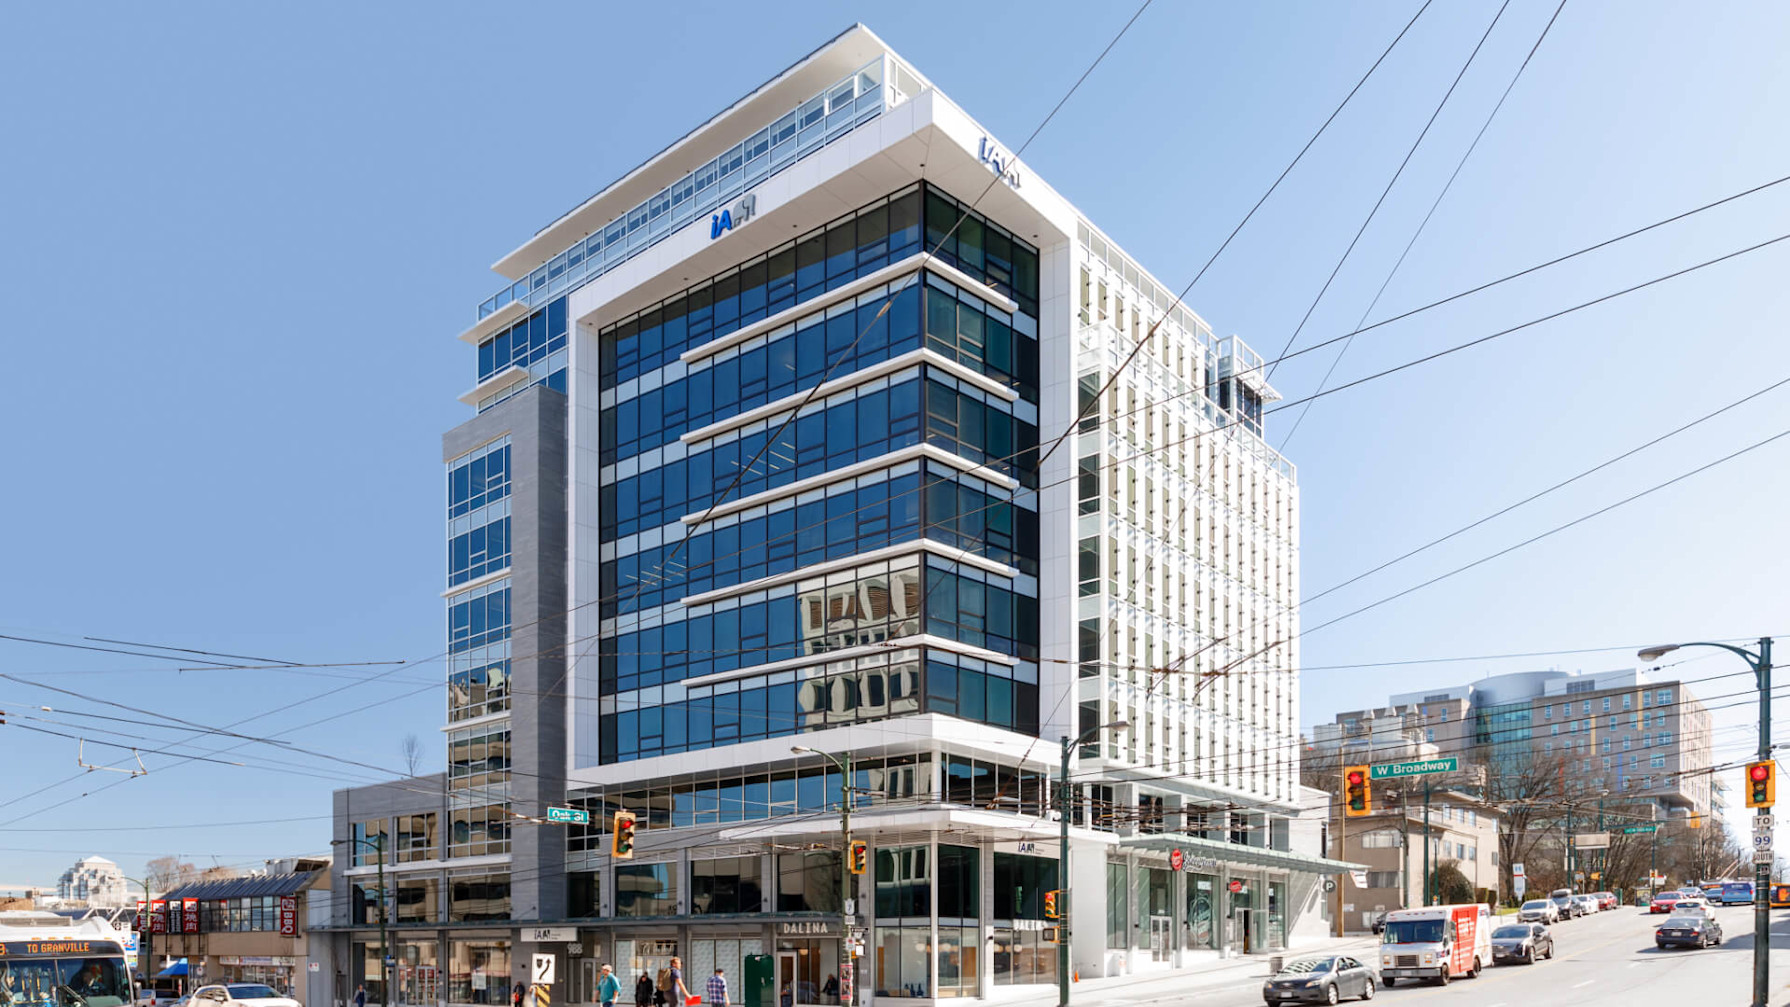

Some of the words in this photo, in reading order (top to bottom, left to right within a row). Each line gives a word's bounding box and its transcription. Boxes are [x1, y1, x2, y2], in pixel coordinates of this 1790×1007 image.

[1376, 766, 1389, 775] W
[1393, 761, 1451, 775] Broadway
[552, 810, 571, 820] Oak
[1756, 817, 1770, 825] TO
[1755, 836, 1770, 846] 99
[1326, 882, 1334, 891] P
[282, 912, 294, 933] BBQ
[783, 922, 828, 934] DALINA
[27, 943, 38, 953] TO
[41, 942, 90, 952] GRANVILLE
[567, 942, 583, 954] 988
